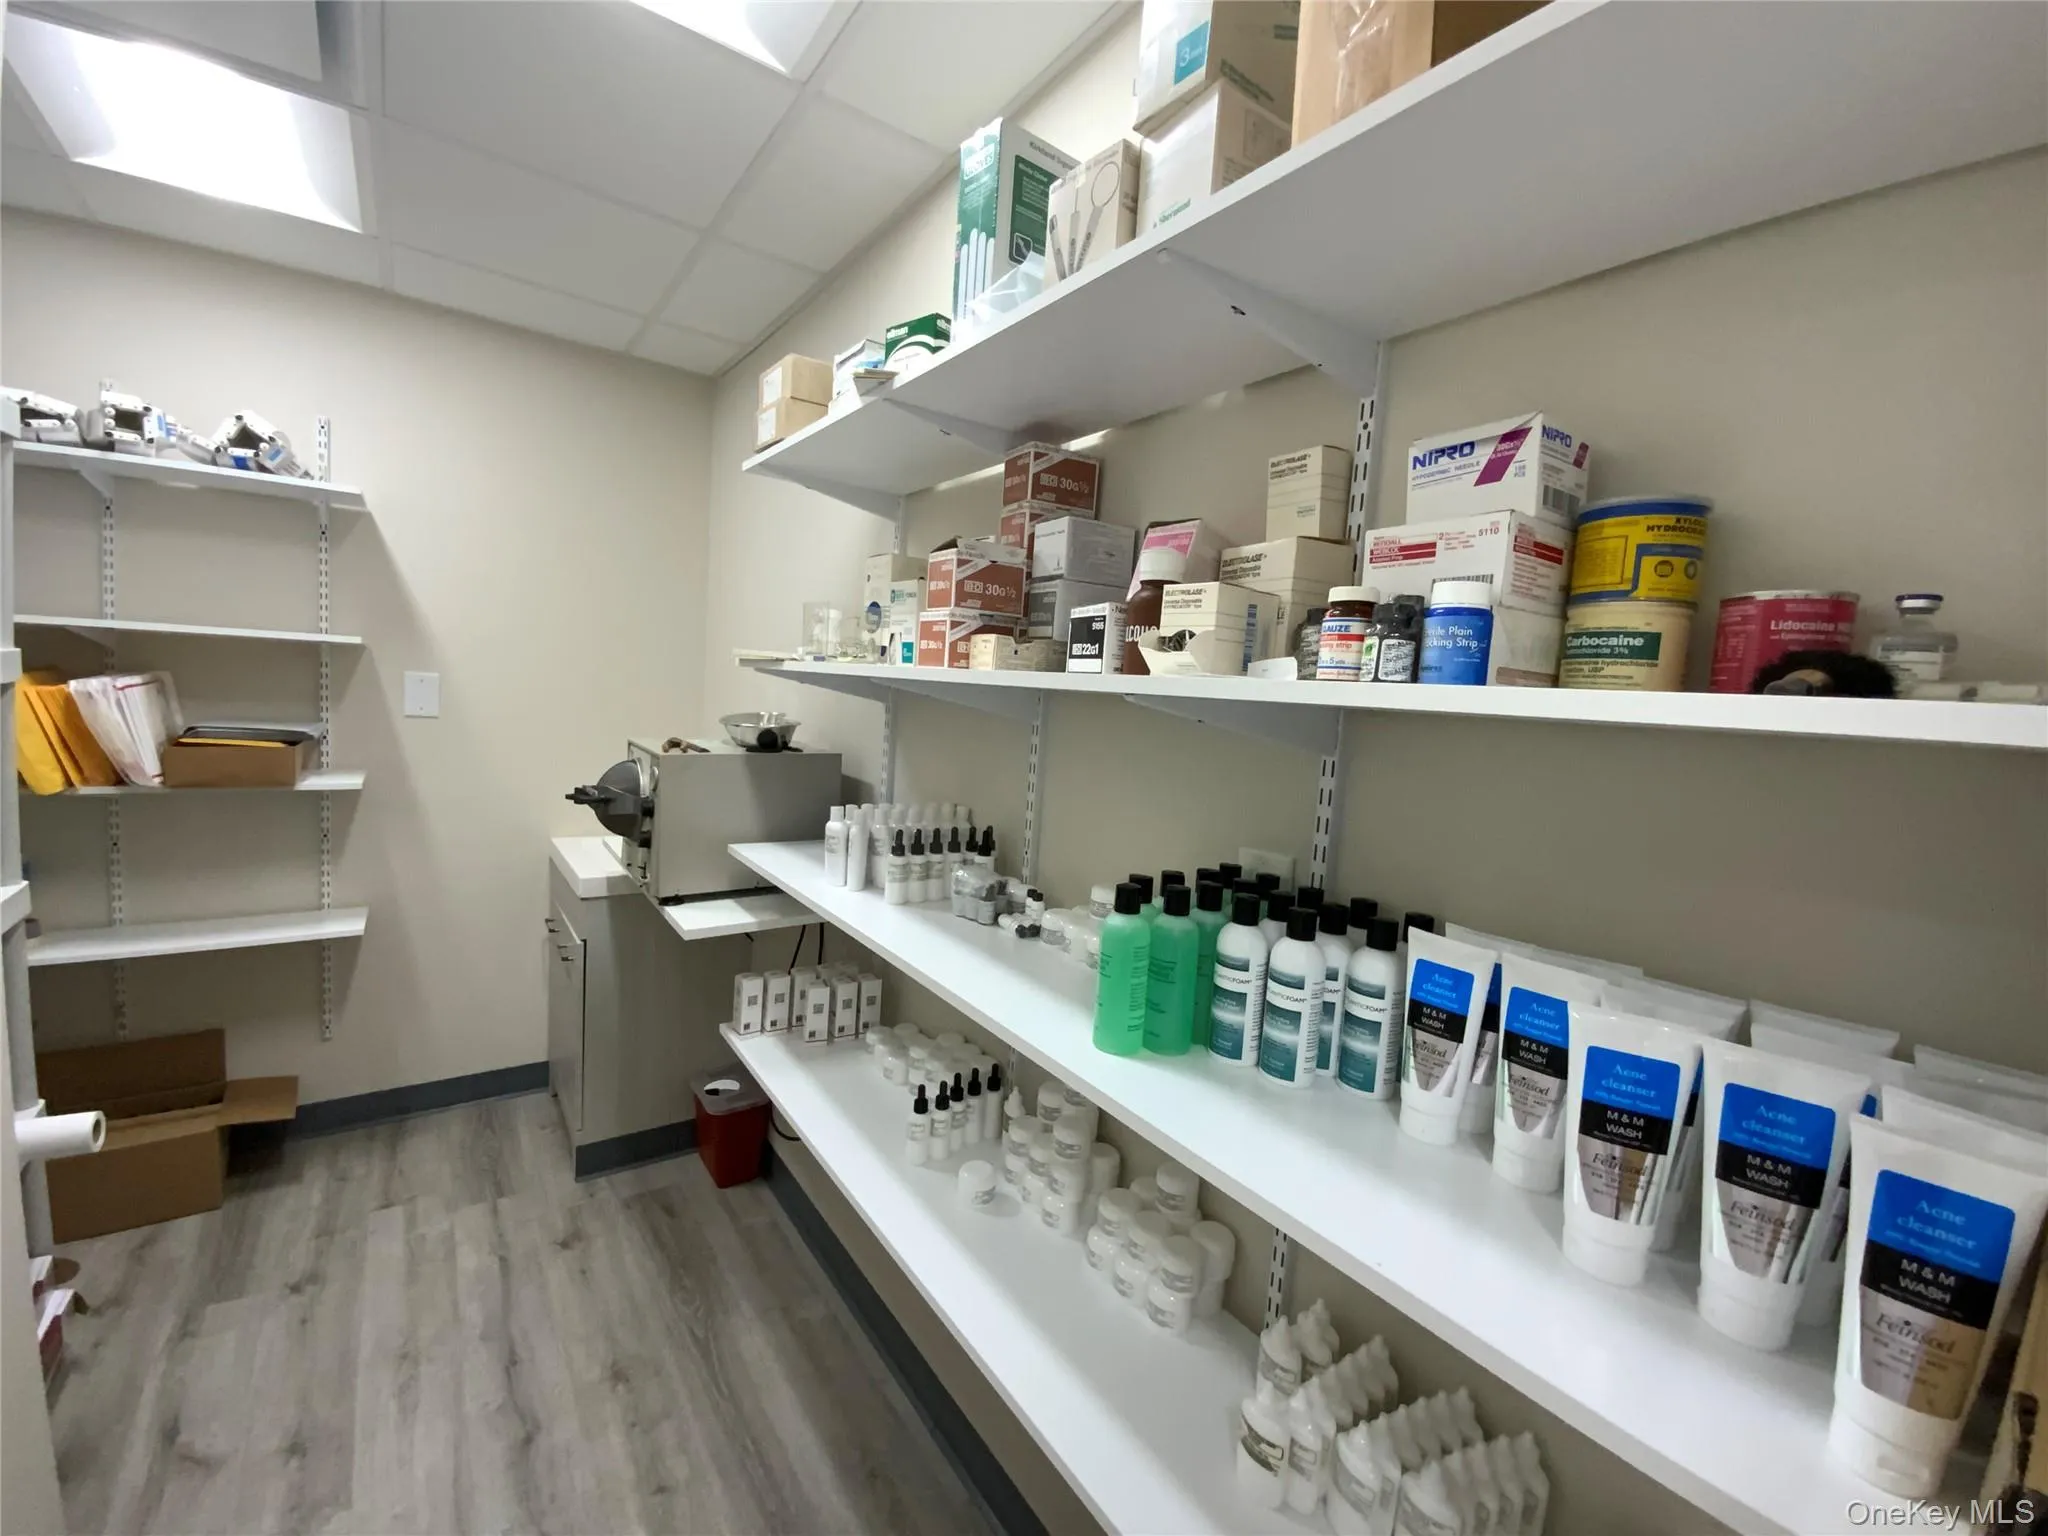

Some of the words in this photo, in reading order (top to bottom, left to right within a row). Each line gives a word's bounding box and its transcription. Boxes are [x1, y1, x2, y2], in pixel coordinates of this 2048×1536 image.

[1541, 425, 1572, 448] NIPRO
[1412, 441, 1476, 470] NIPRO
[1454, 461, 1480, 471] NEEDLE
[1478, 527, 1500, 536] 5110
[1449, 625, 1473, 636] Plain
[1770, 620, 1835, 631] Lidocaine
[1426, 637, 1453, 649] cking
[1456, 637, 1478, 650] Strip
[1566, 634, 1645, 647] Carbocaine
[1530, 1003, 1557, 1017] Acne
[1519, 1013, 1560, 1031] cleanser
[1519, 1050, 1546, 1065] WASH
[1612, 1064, 1648, 1081] Acne
[1601, 1077, 1657, 1098] cleanser
[1755, 1105, 1798, 1124] Acne
[1606, 1123, 1643, 1140] WASH
[1741, 1119, 1806, 1145] cleanser
[1747, 1154, 1761, 1167] M
[1777, 1163, 1792, 1175] M
[1746, 1168, 1790, 1189] WASH
[1916, 1199, 1966, 1226] Acne
[1897, 1215, 1978, 1249] cleanser
[1900, 1258, 1918, 1275] M
[1938, 1271, 1956, 1287] M
[1899, 1276, 1952, 1304] WASH
